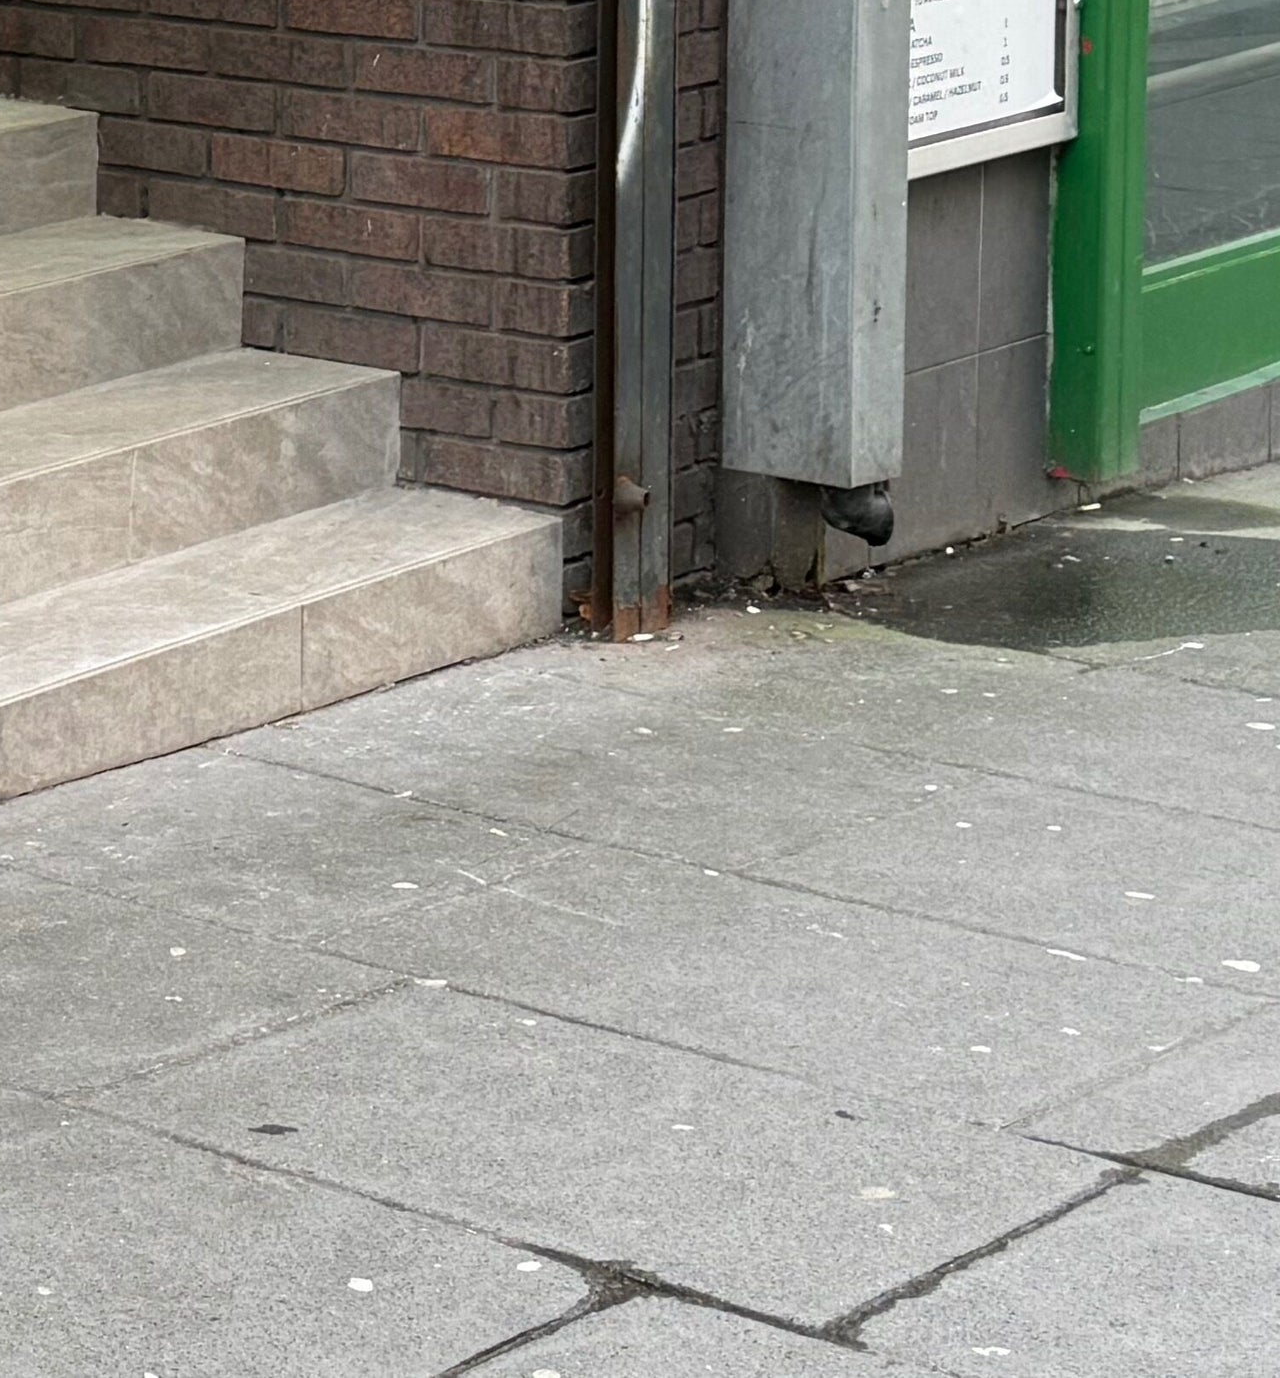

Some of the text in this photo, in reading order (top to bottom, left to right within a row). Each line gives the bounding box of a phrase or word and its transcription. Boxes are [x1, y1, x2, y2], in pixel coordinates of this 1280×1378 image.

[911, 52, 943, 68] ESPRESSO
[917, 70, 948, 86] COCONUT
[949, 66, 965, 79] MILK
[913, 90, 943, 106] CARAMEL
[926, 110, 938, 121] TOP
